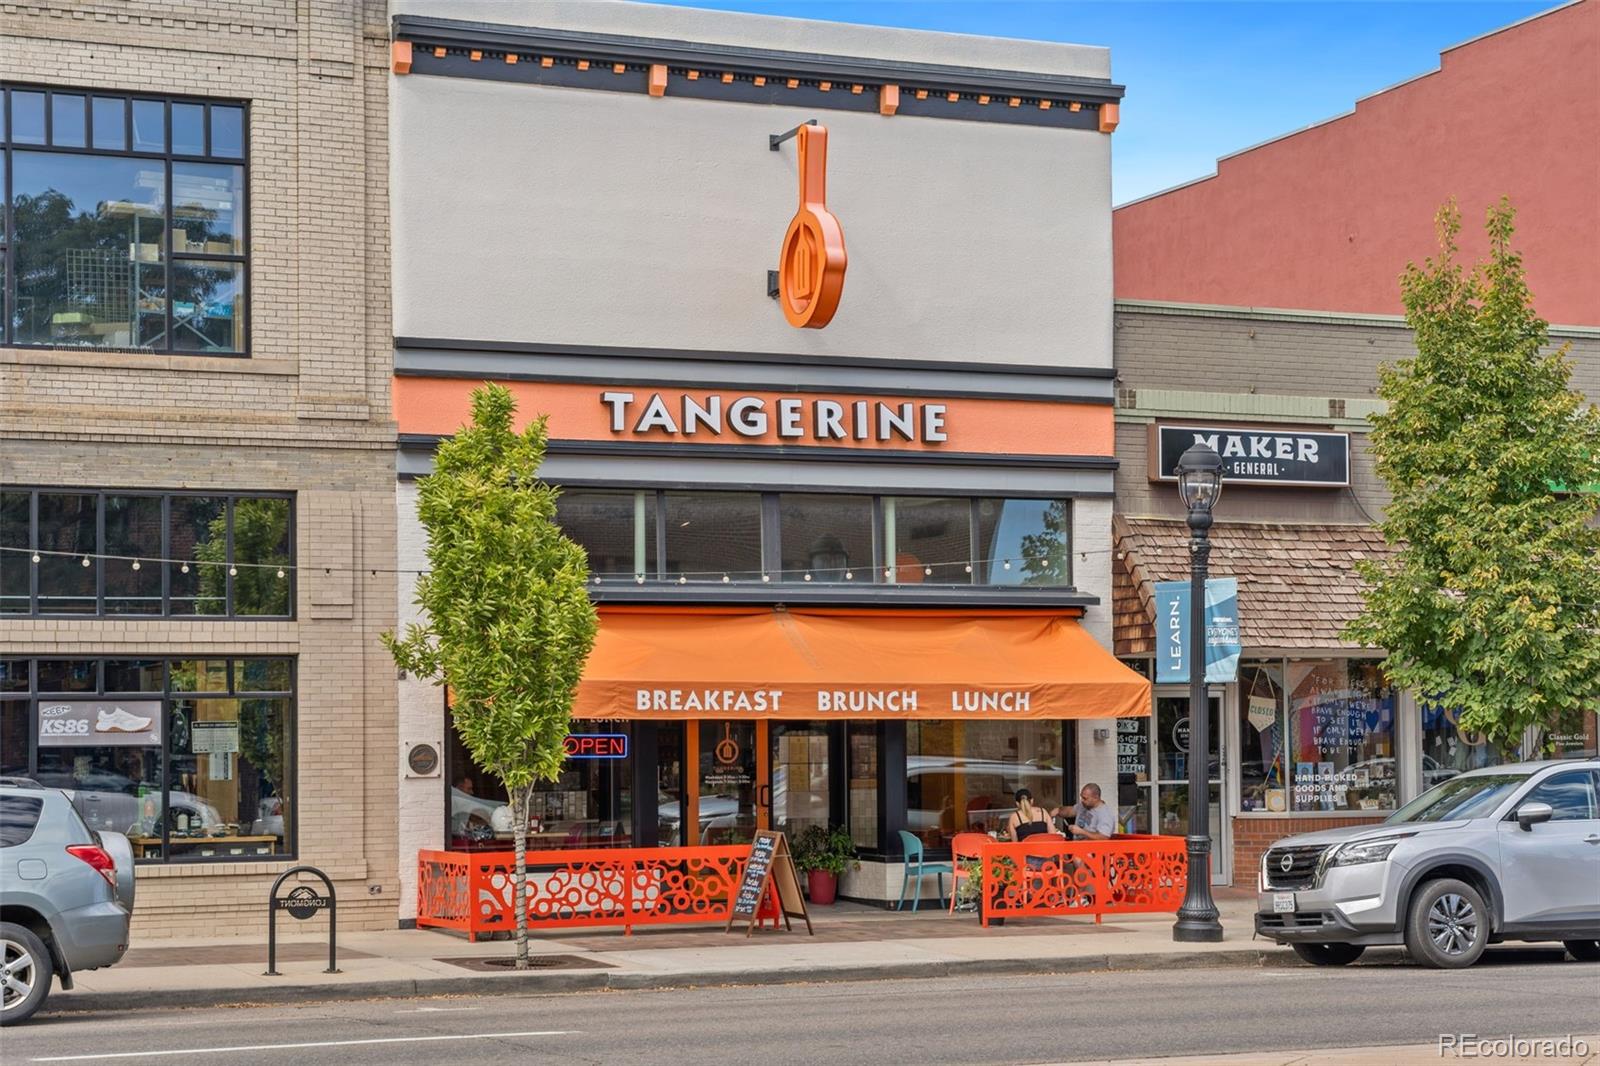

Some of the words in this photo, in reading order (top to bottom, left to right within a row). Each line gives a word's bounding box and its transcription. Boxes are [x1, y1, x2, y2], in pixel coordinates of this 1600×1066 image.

[601, 391, 948, 443] TANGERINE
[1234, 461, 1279, 476] GENERAL
[1170, 596, 1181, 670] LEARN.
[636, 689, 783, 712] BREAKFAST
[817, 690, 918, 712] BRUNCH
[951, 691, 1031, 712] LUNCH
[1250, 705, 1274, 717] CLOSED
[41, 719, 89, 733] KS86
[1573, 733, 1590, 741] Gold
[563, 737, 624, 755] OPEN
[1294, 774, 1358, 783] HAND-PICKED
[1294, 784, 1326, 793] GOODS
[1329, 784, 1348, 792] AND
[1294, 794, 1338, 803] SUPPLIES
